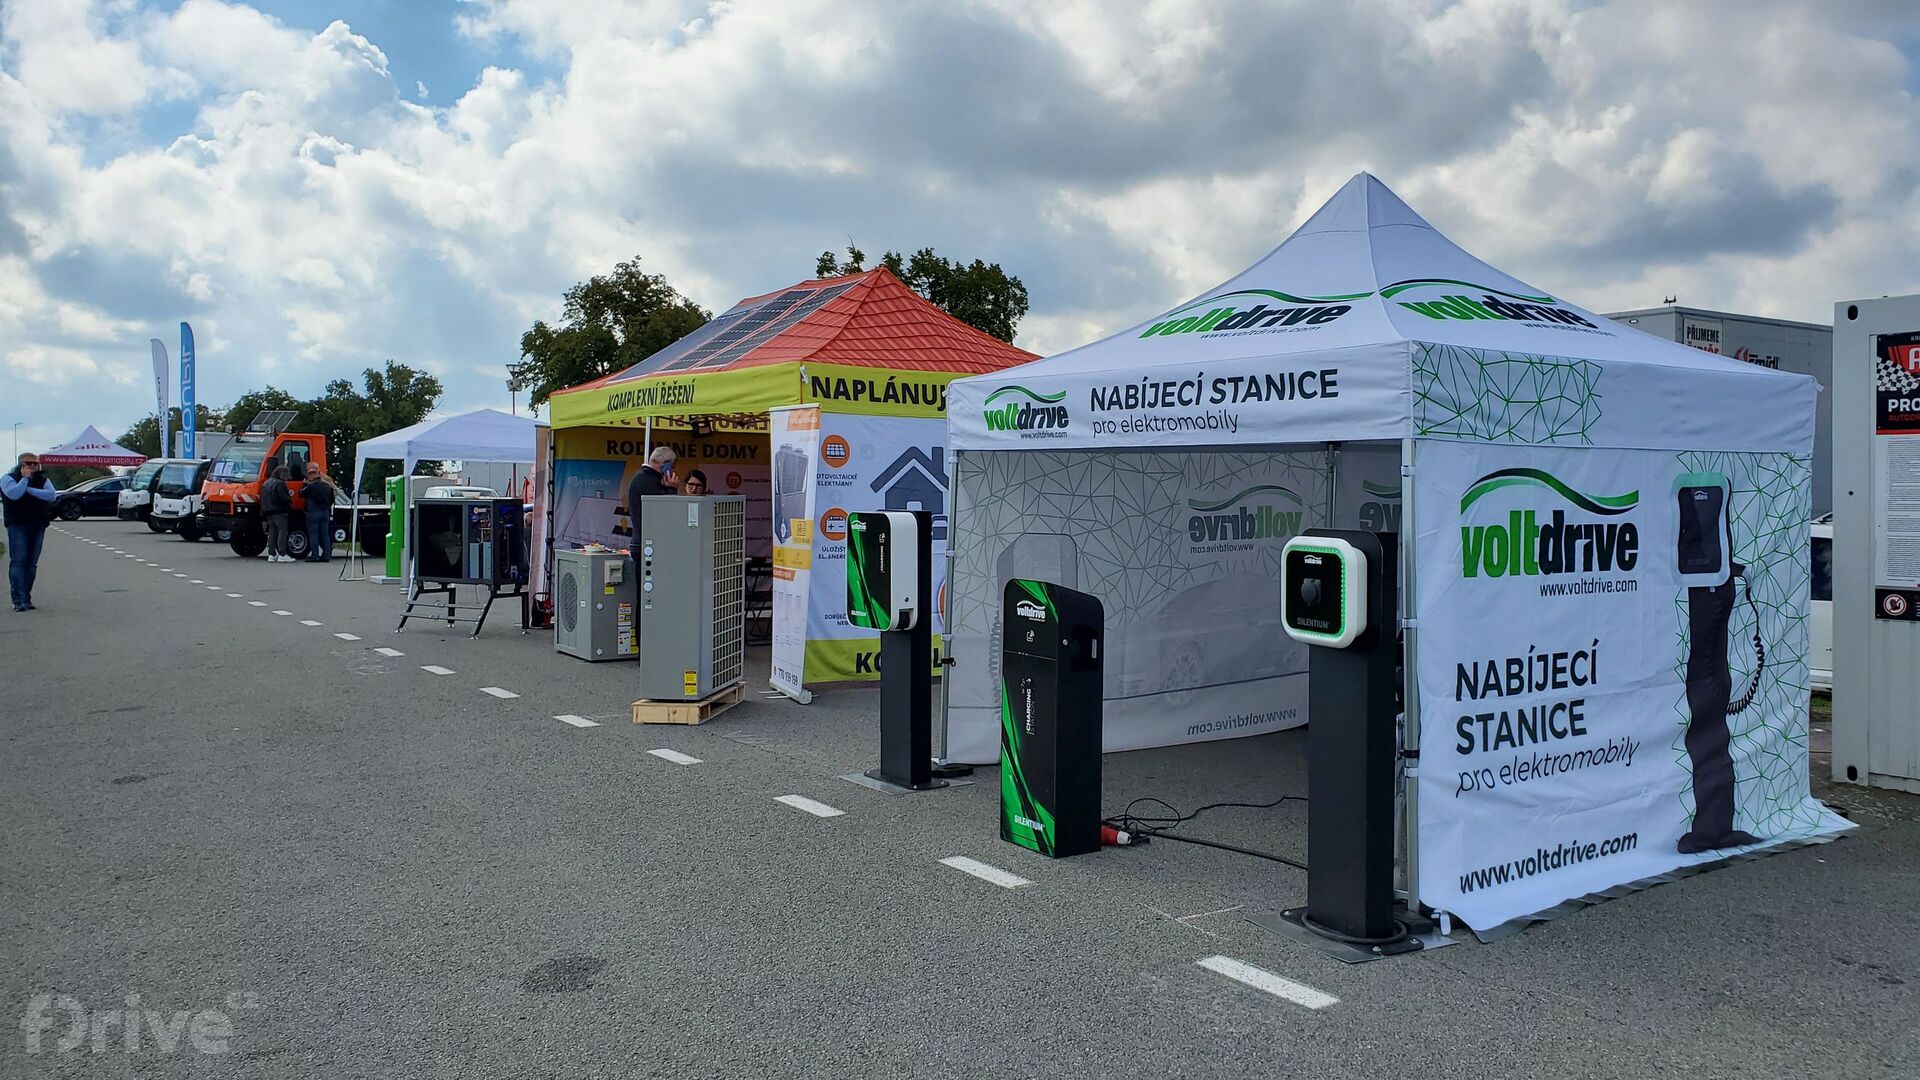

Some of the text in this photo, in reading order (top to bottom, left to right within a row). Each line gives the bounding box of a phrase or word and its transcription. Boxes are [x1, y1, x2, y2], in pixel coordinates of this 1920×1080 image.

[1138, 304, 1351, 339] voltdrive
[1397, 295, 1598, 329] voltdrive
[1200, 325, 1321, 339] www.voltdrive.com
[1686, 324, 1720, 343] PŘIJMEME
[607, 378, 696, 412] KOMPLEXNÍ ŘEŠENÍ
[1090, 368, 1339, 412] NABÍJECÍ STANICE
[983, 402, 1069, 431] voltdrive
[1092, 409, 1239, 438] pro elektromobily
[606, 440, 759, 460] RODNÉ DOMY
[1461, 509, 1639, 579] voltdrive
[1540, 577, 1638, 598] www.voltdrive.com
[1296, 617, 1329, 629] SILENTIUM
[1455, 638, 1600, 702] NABÍJECÍ
[1455, 698, 1588, 756] STANICE
[1455, 735, 1641, 798] pro elektromobily
[1460, 831, 1638, 895] www.voltdrive.com
